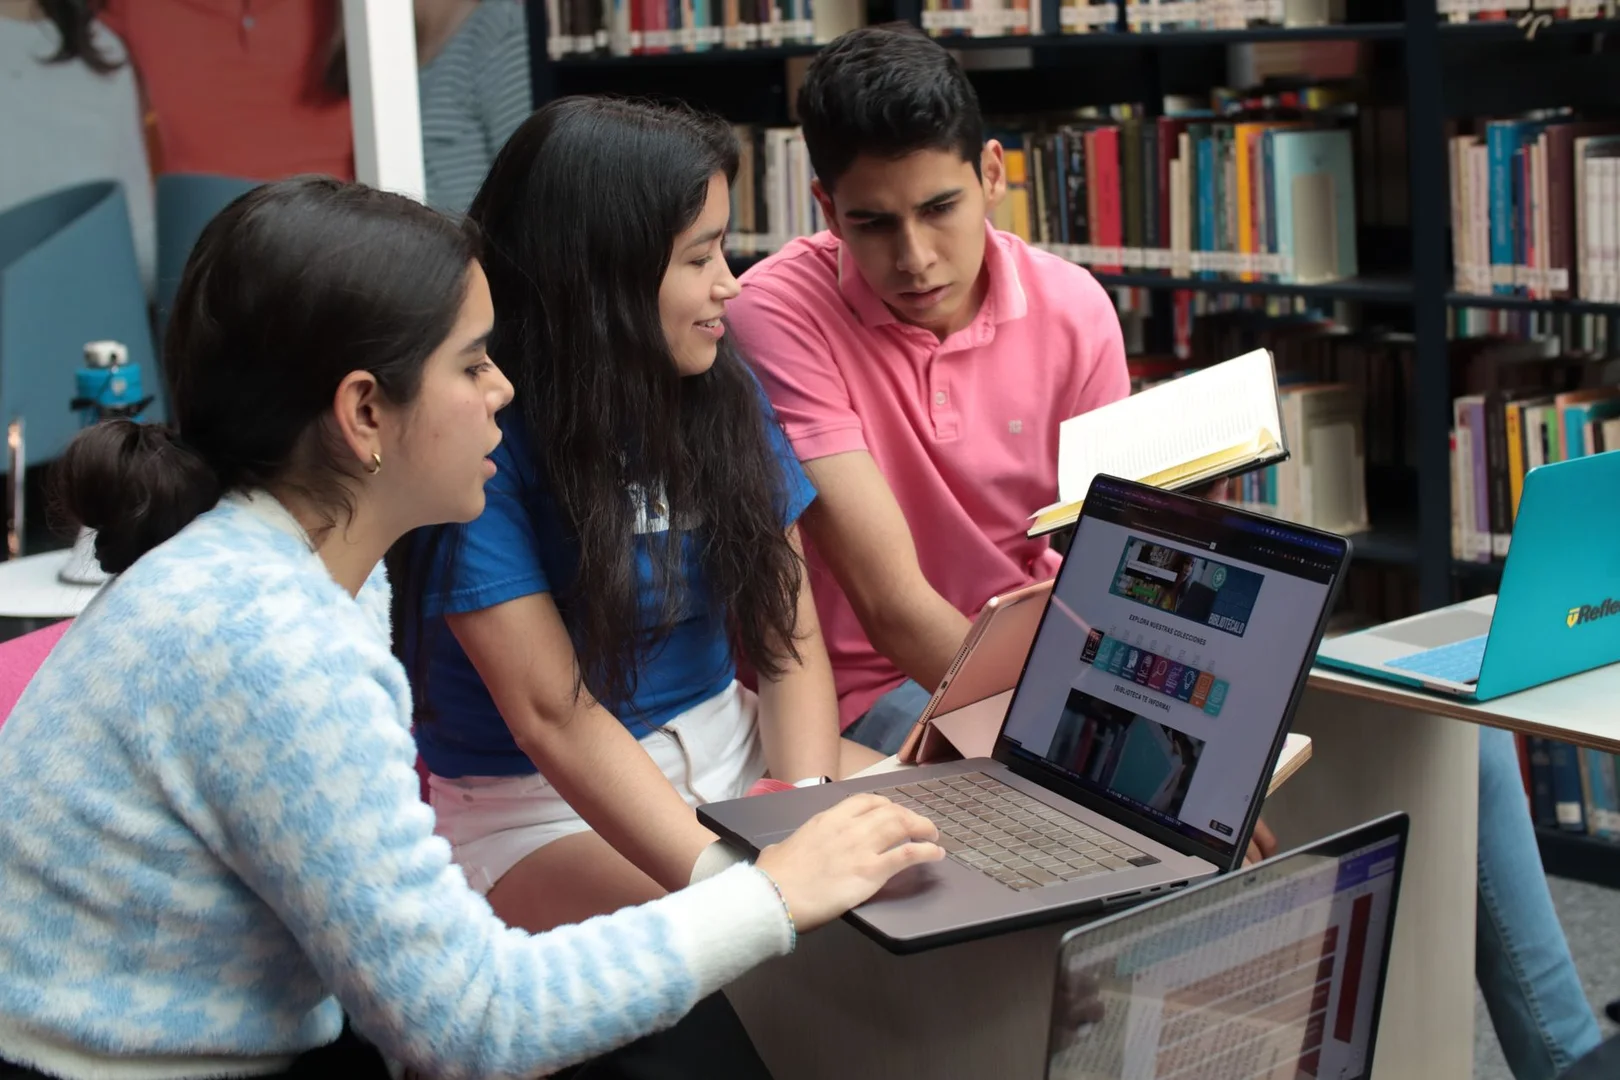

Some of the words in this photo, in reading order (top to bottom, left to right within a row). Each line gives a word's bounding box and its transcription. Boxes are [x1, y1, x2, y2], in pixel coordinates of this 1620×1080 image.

[1129, 614, 1149, 626] EXPLORA
[1150, 621, 1174, 635] NUESTRAS
[1174, 629, 1207, 646] COLECCIONES
[1208, 612, 1245, 635] BIBLIOTÉCALO
[1142, 694, 1149, 703] TE
